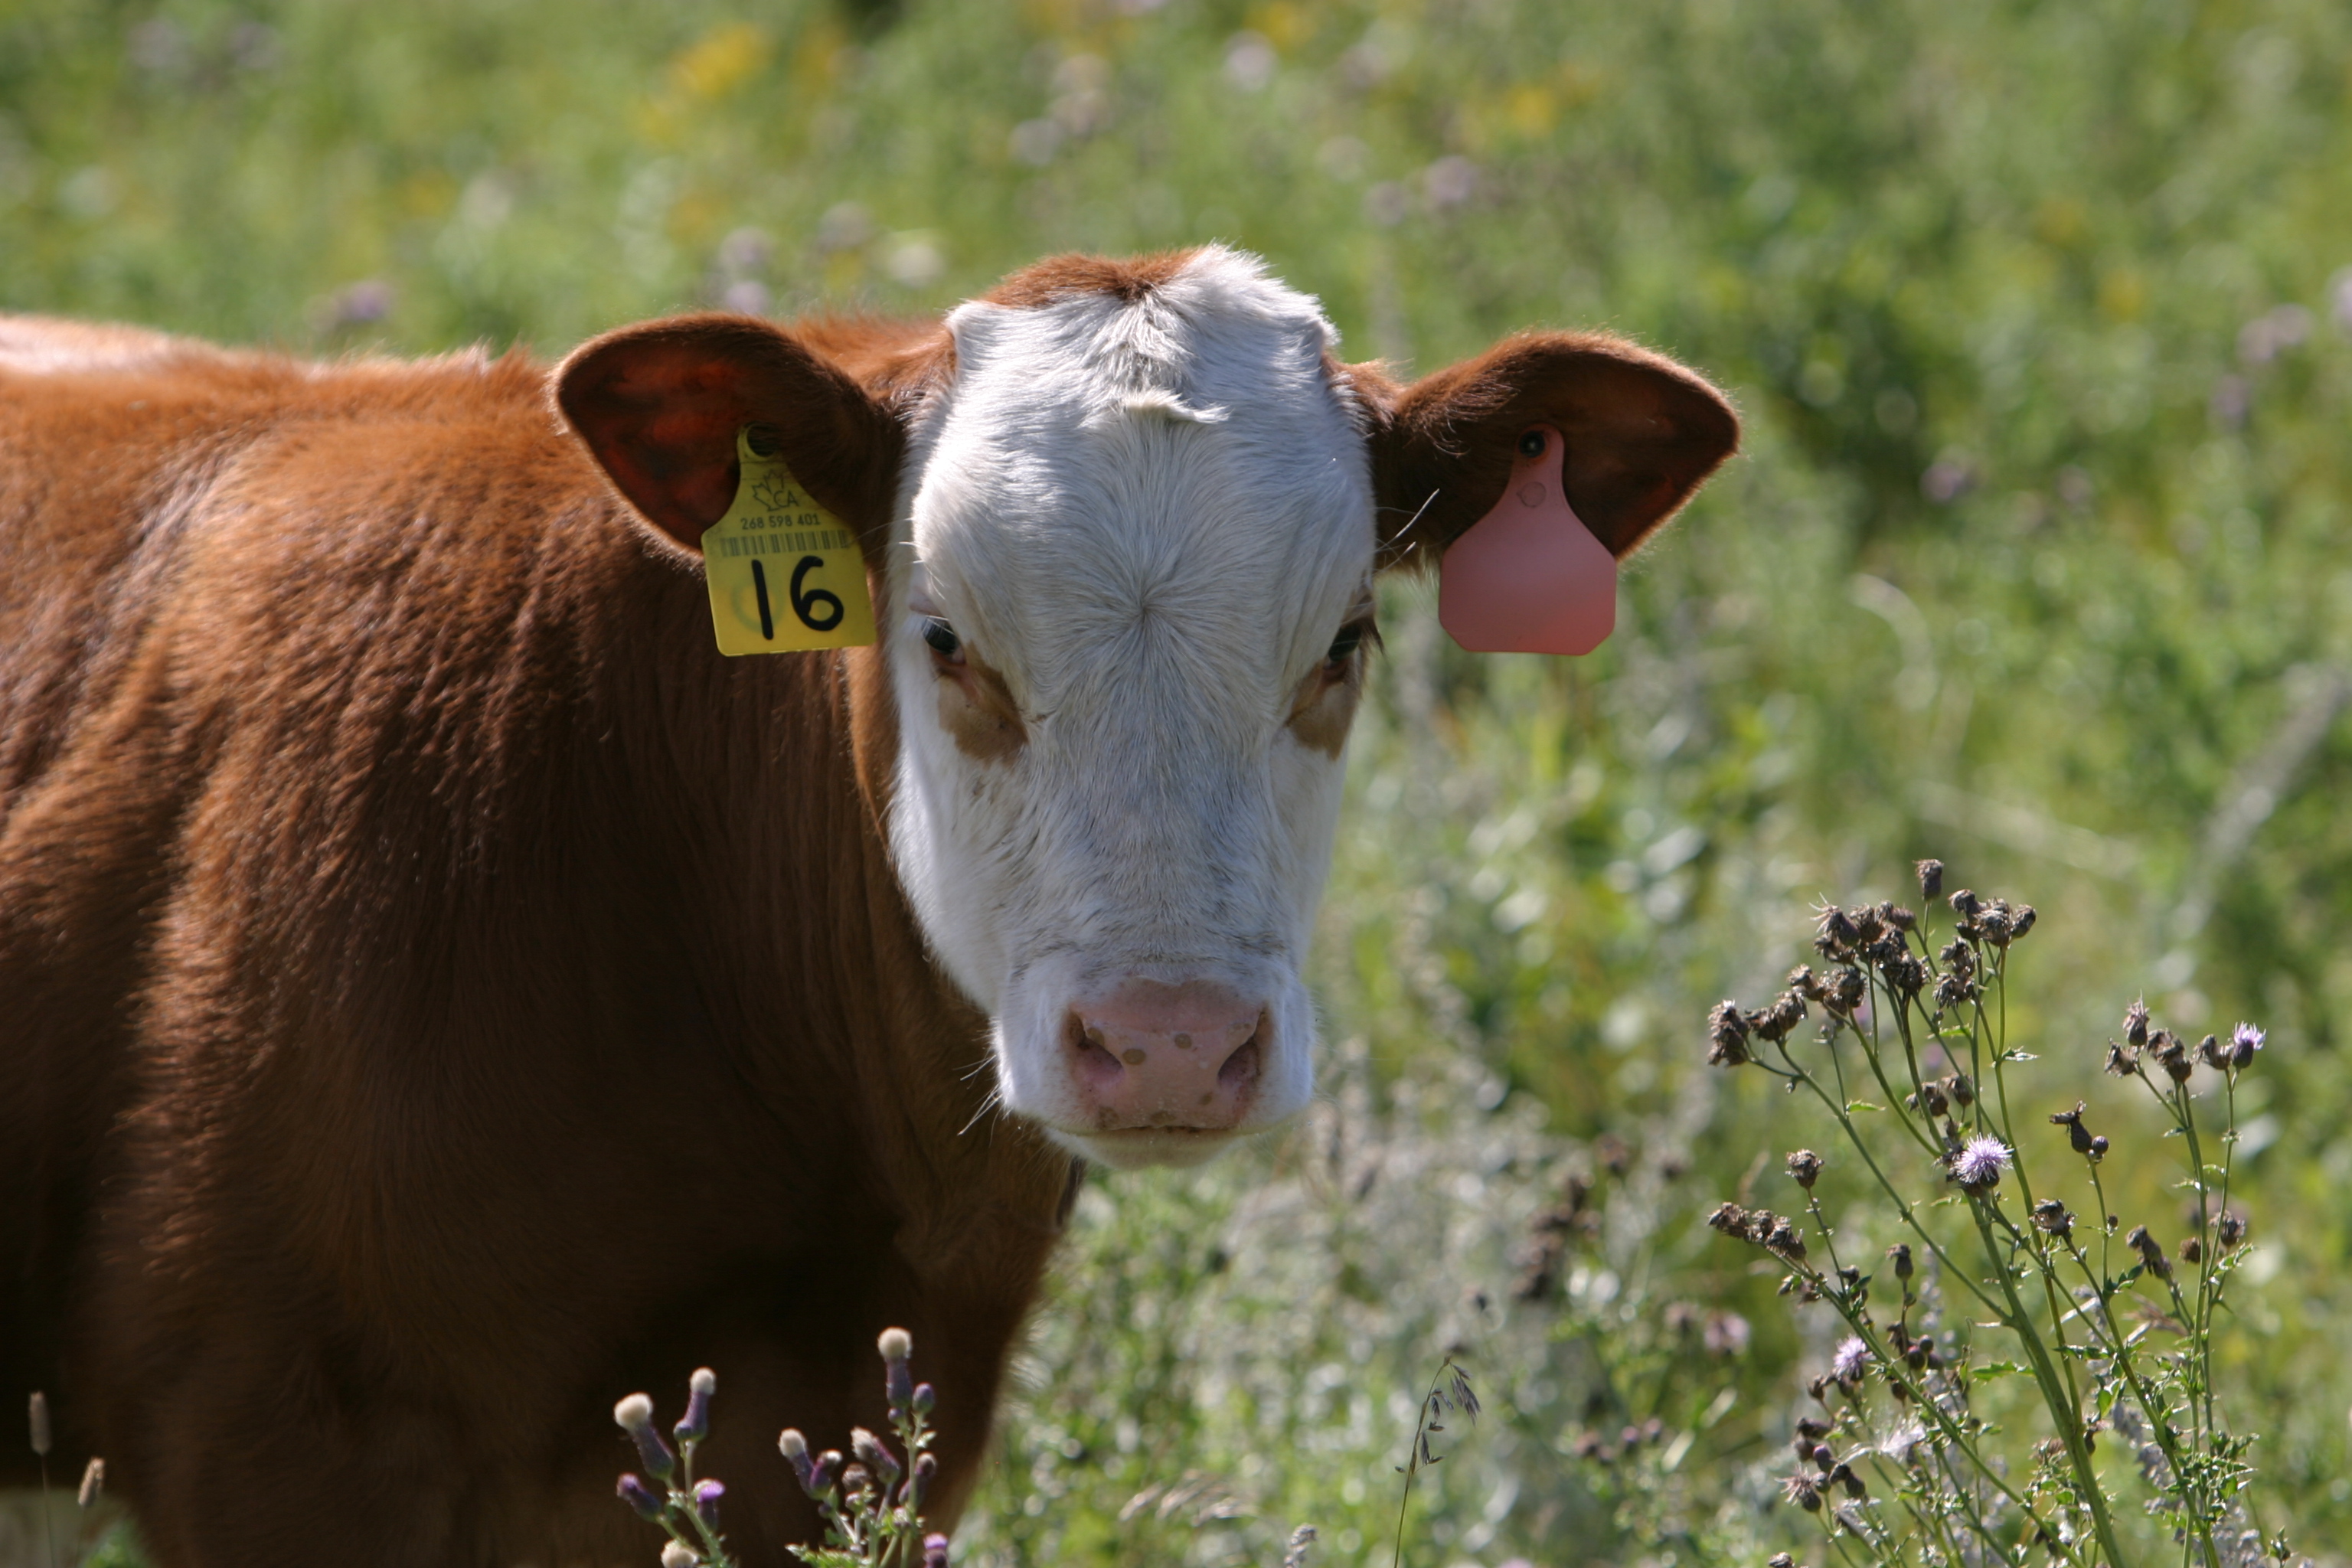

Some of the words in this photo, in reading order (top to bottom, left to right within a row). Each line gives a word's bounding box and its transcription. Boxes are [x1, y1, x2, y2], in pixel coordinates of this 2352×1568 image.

[773, 490, 799, 508] CA
[740, 516, 764, 530] 268
[769, 514, 792, 528] 598
[798, 513, 821, 526] 401
[751, 555, 844, 640] 16
